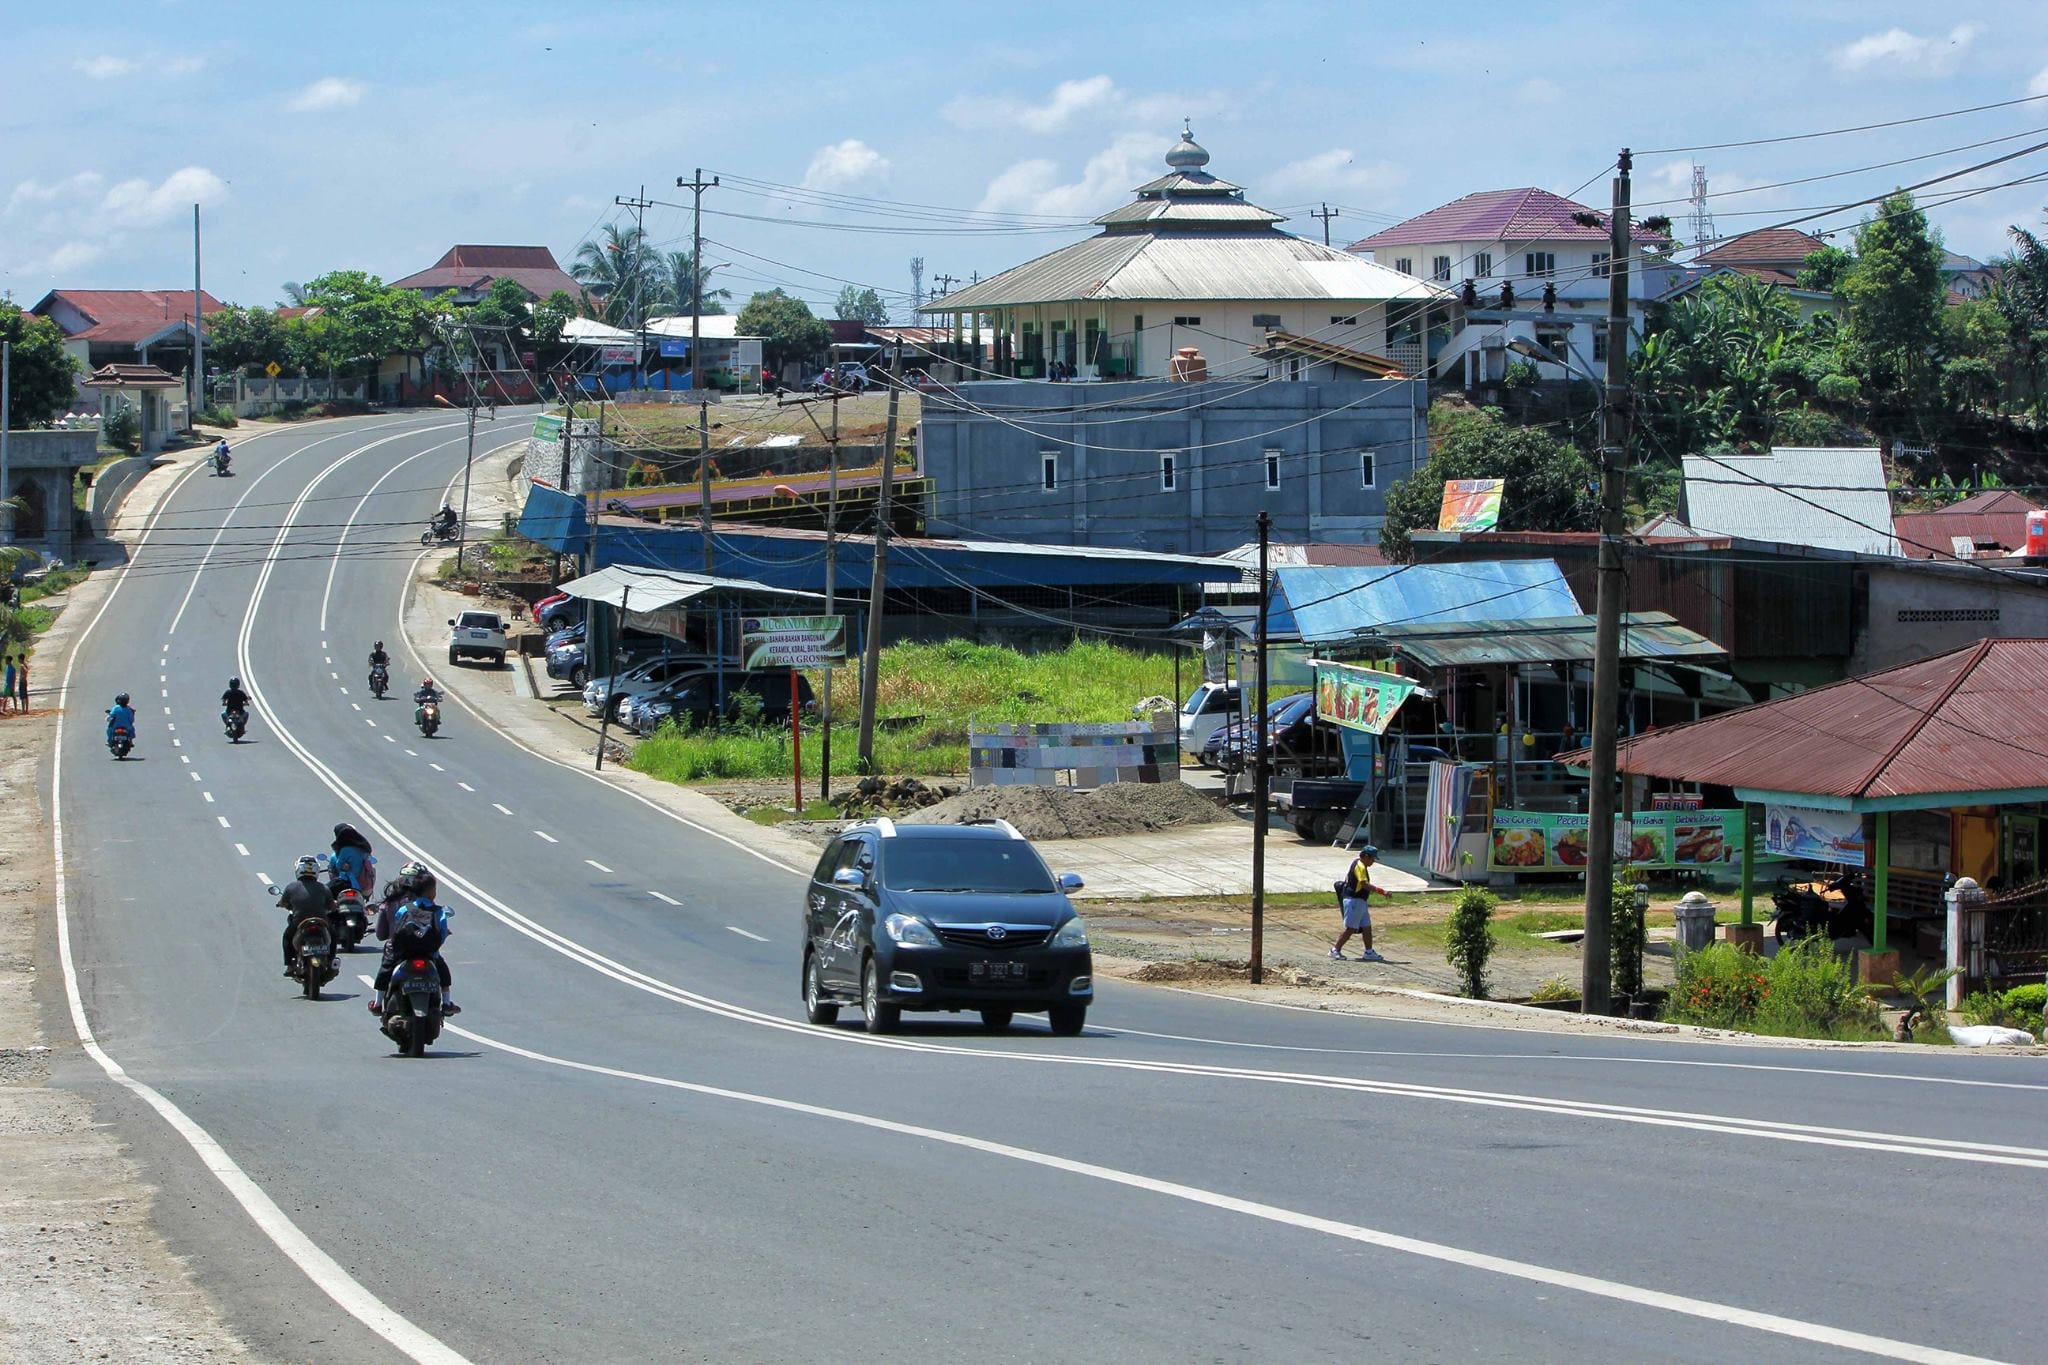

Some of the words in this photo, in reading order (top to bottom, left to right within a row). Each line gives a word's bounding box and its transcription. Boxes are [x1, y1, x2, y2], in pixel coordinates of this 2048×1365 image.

[769, 635, 800, 643] BAHAN-BAHAN
[801, 634, 825, 642] BANGUNAN
[763, 655, 795, 665] HARGA
